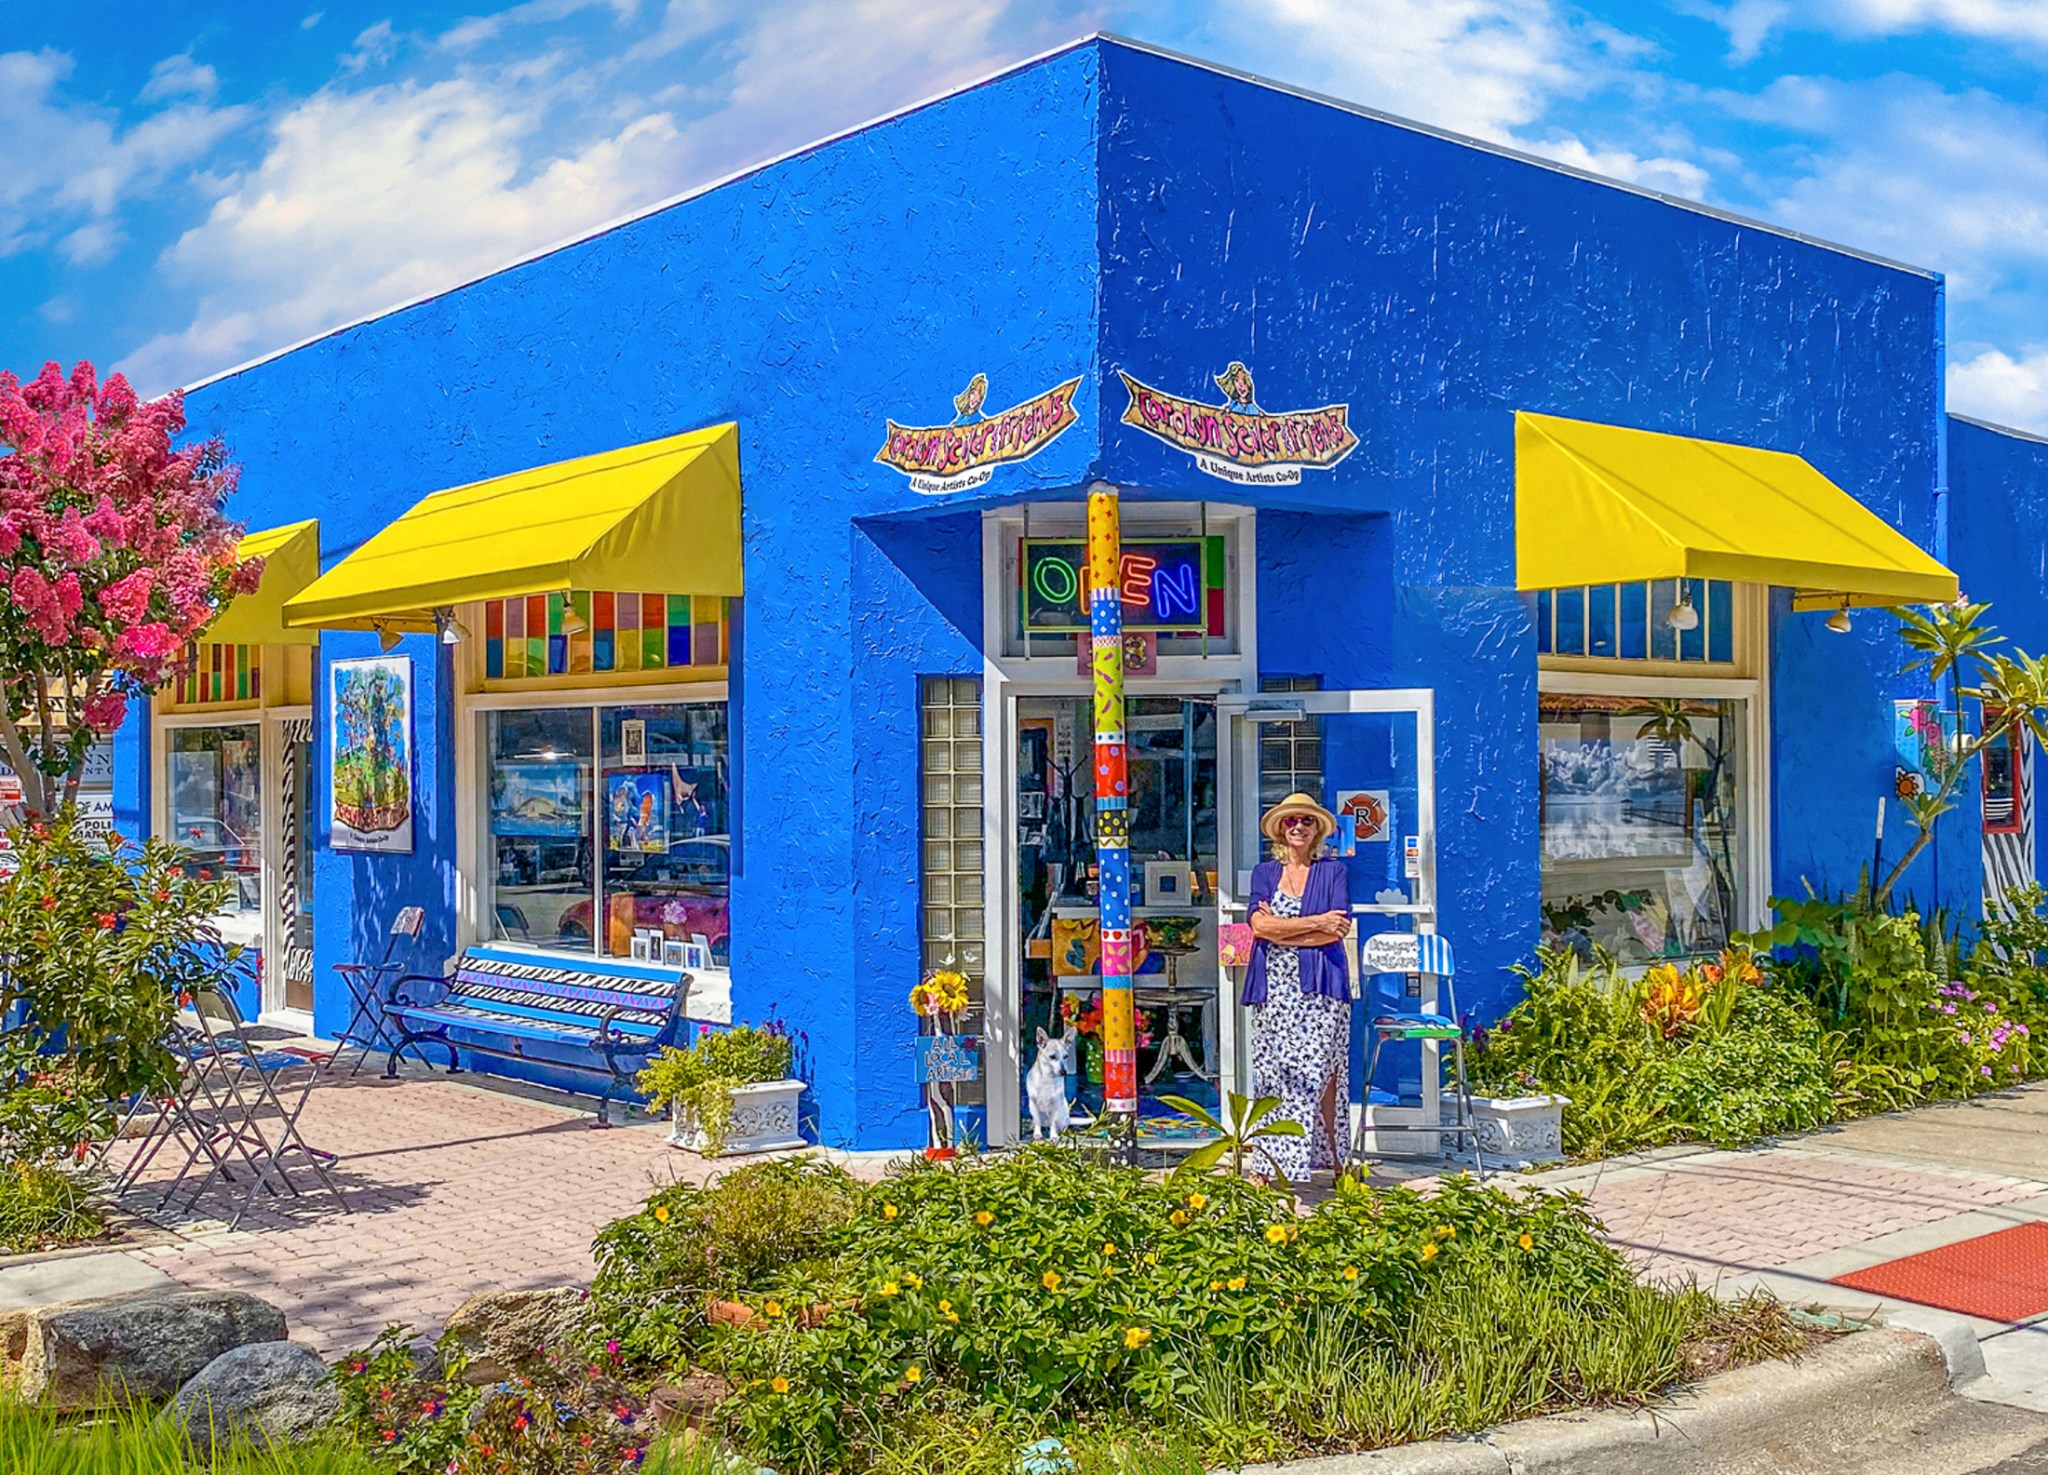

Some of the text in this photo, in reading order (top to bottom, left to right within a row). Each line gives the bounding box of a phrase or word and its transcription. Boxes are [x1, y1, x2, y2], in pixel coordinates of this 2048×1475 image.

[1200, 458, 1300, 483] A Unique Artists Co-Op
[911, 476, 917, 488] A
[940, 479, 966, 492] Artists
[1033, 553, 1197, 618] OEN
[1355, 807, 1371, 825] R
[931, 1037, 959, 1051] ALL
[925, 1050, 971, 1067] LOCAL
